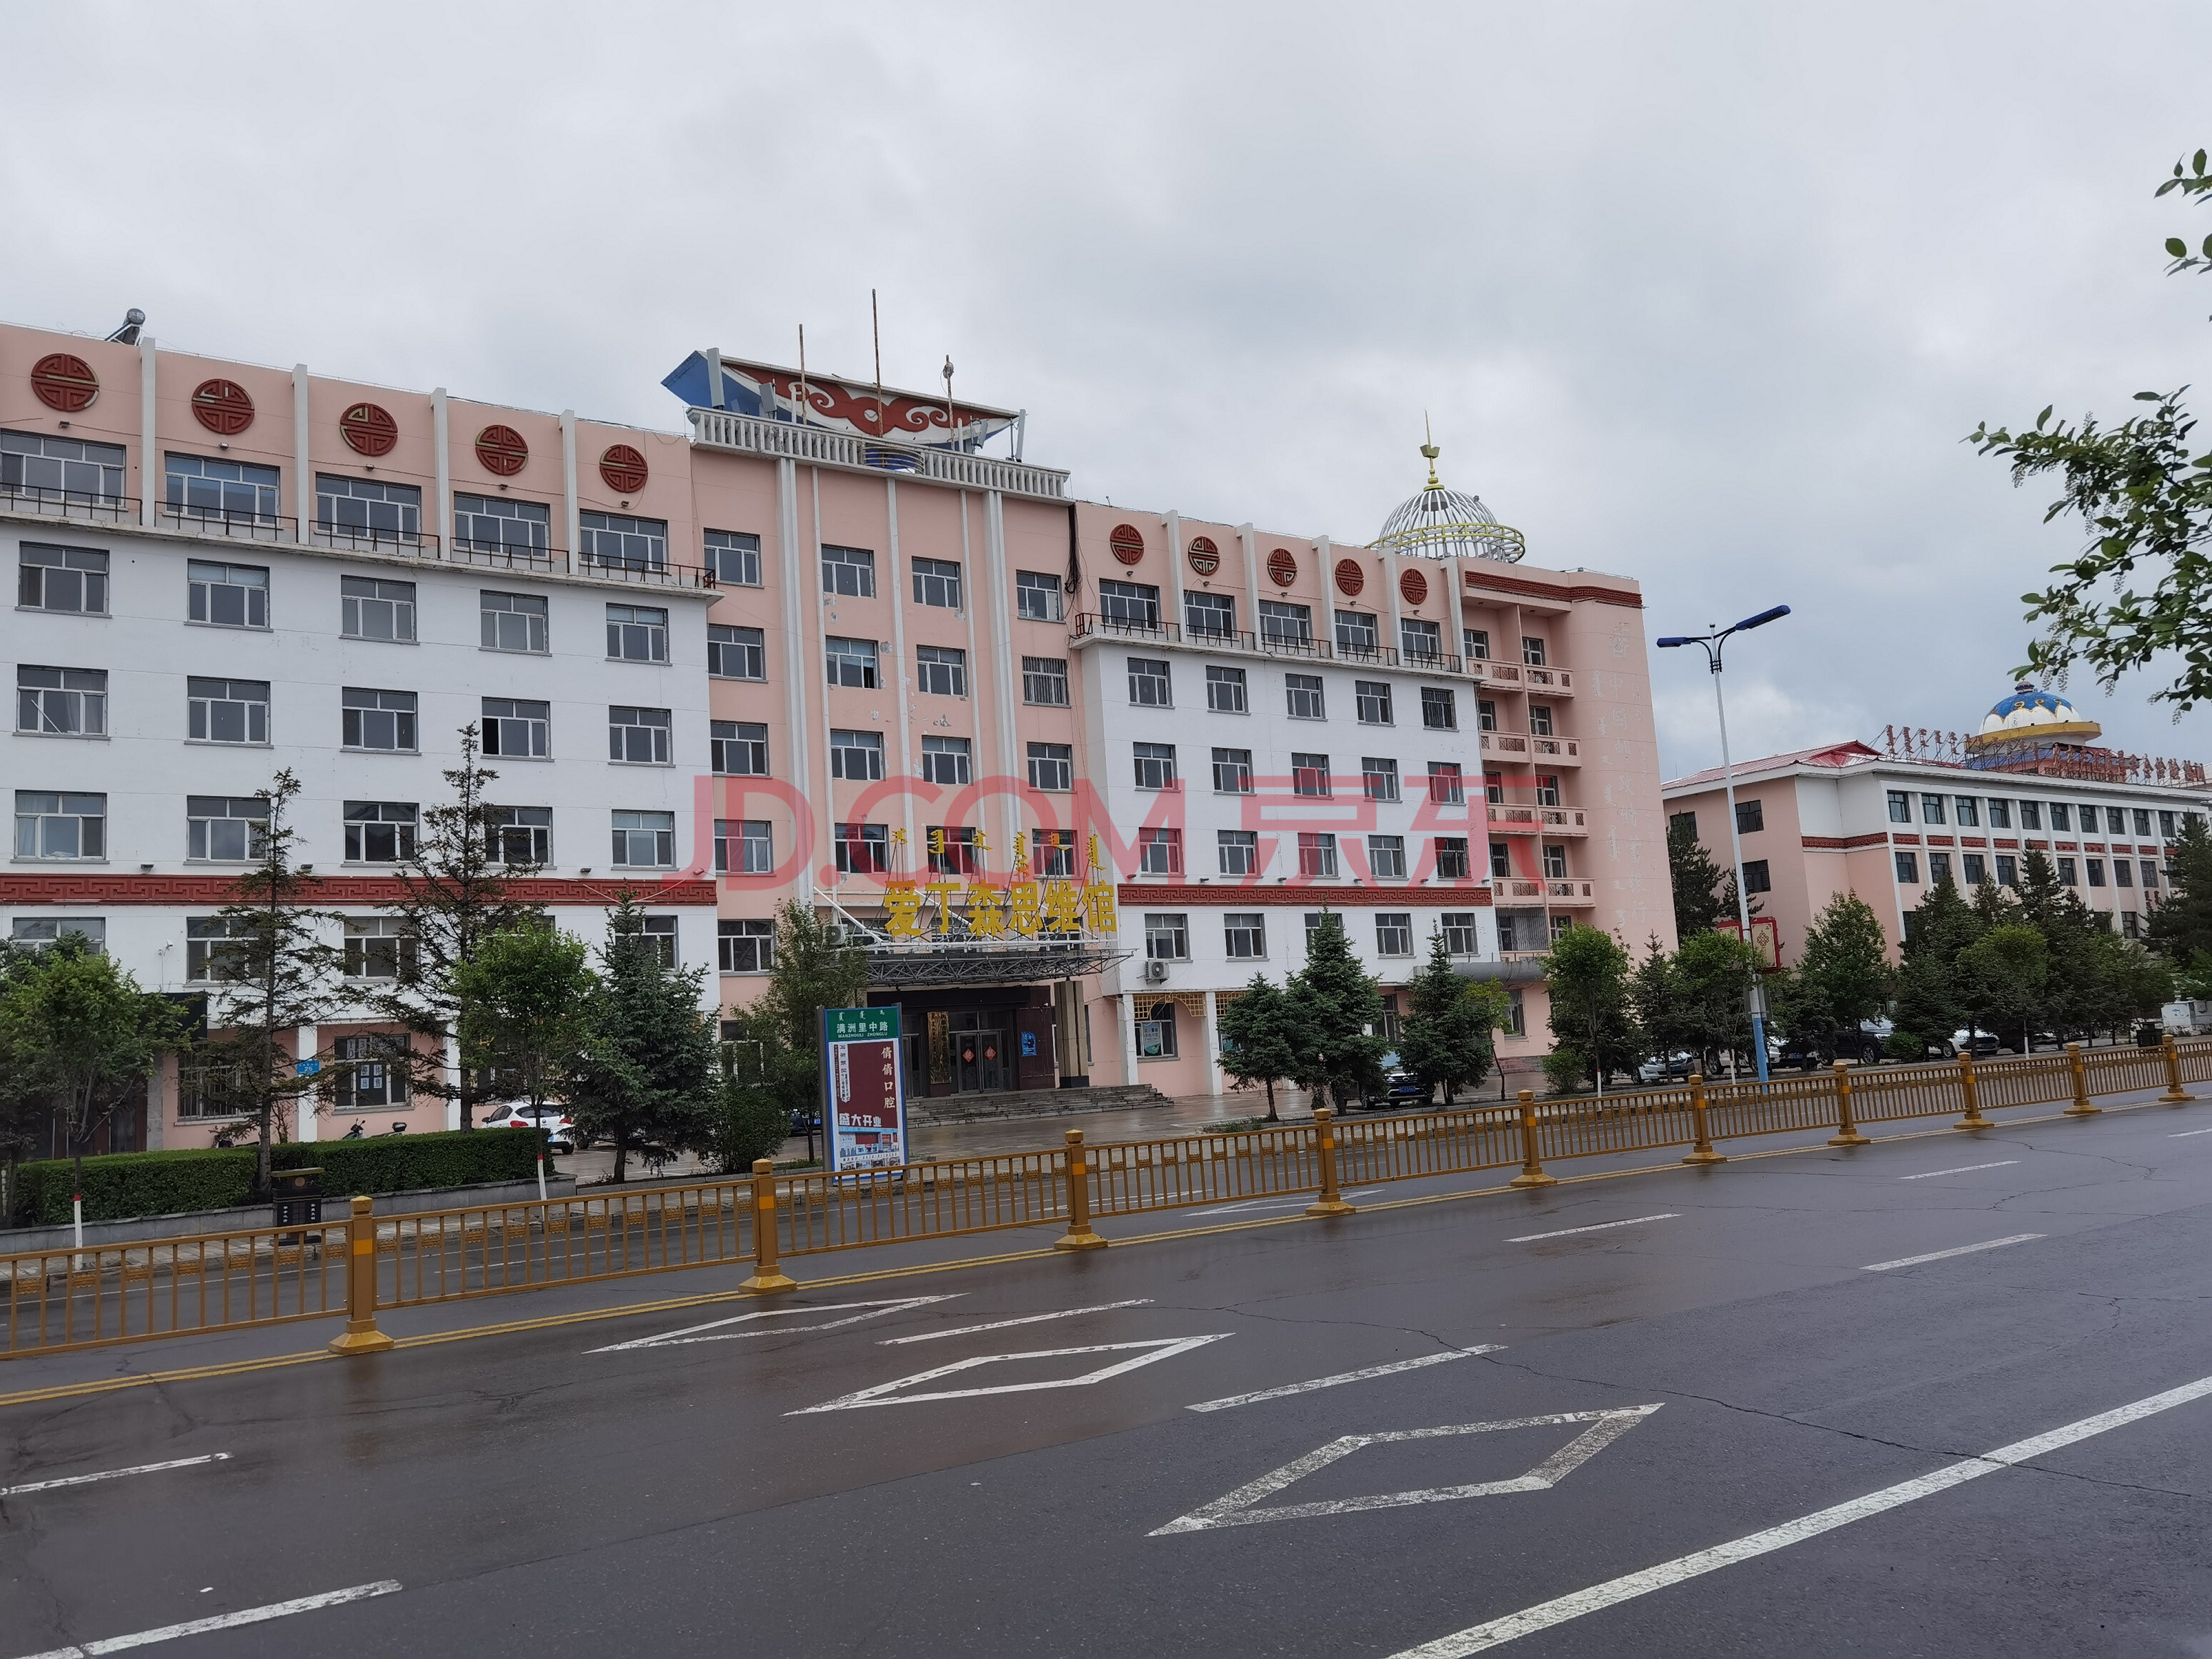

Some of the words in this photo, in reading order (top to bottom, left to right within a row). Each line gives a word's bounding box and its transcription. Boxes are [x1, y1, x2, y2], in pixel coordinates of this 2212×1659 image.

[885, 880, 1117, 937] 爱丁森思维馆
[837, 1021, 888, 1034] 满洲里中路
[881, 1046, 896, 1109] 倩倩口腔
[839, 1112, 882, 1127] 盛大开业
